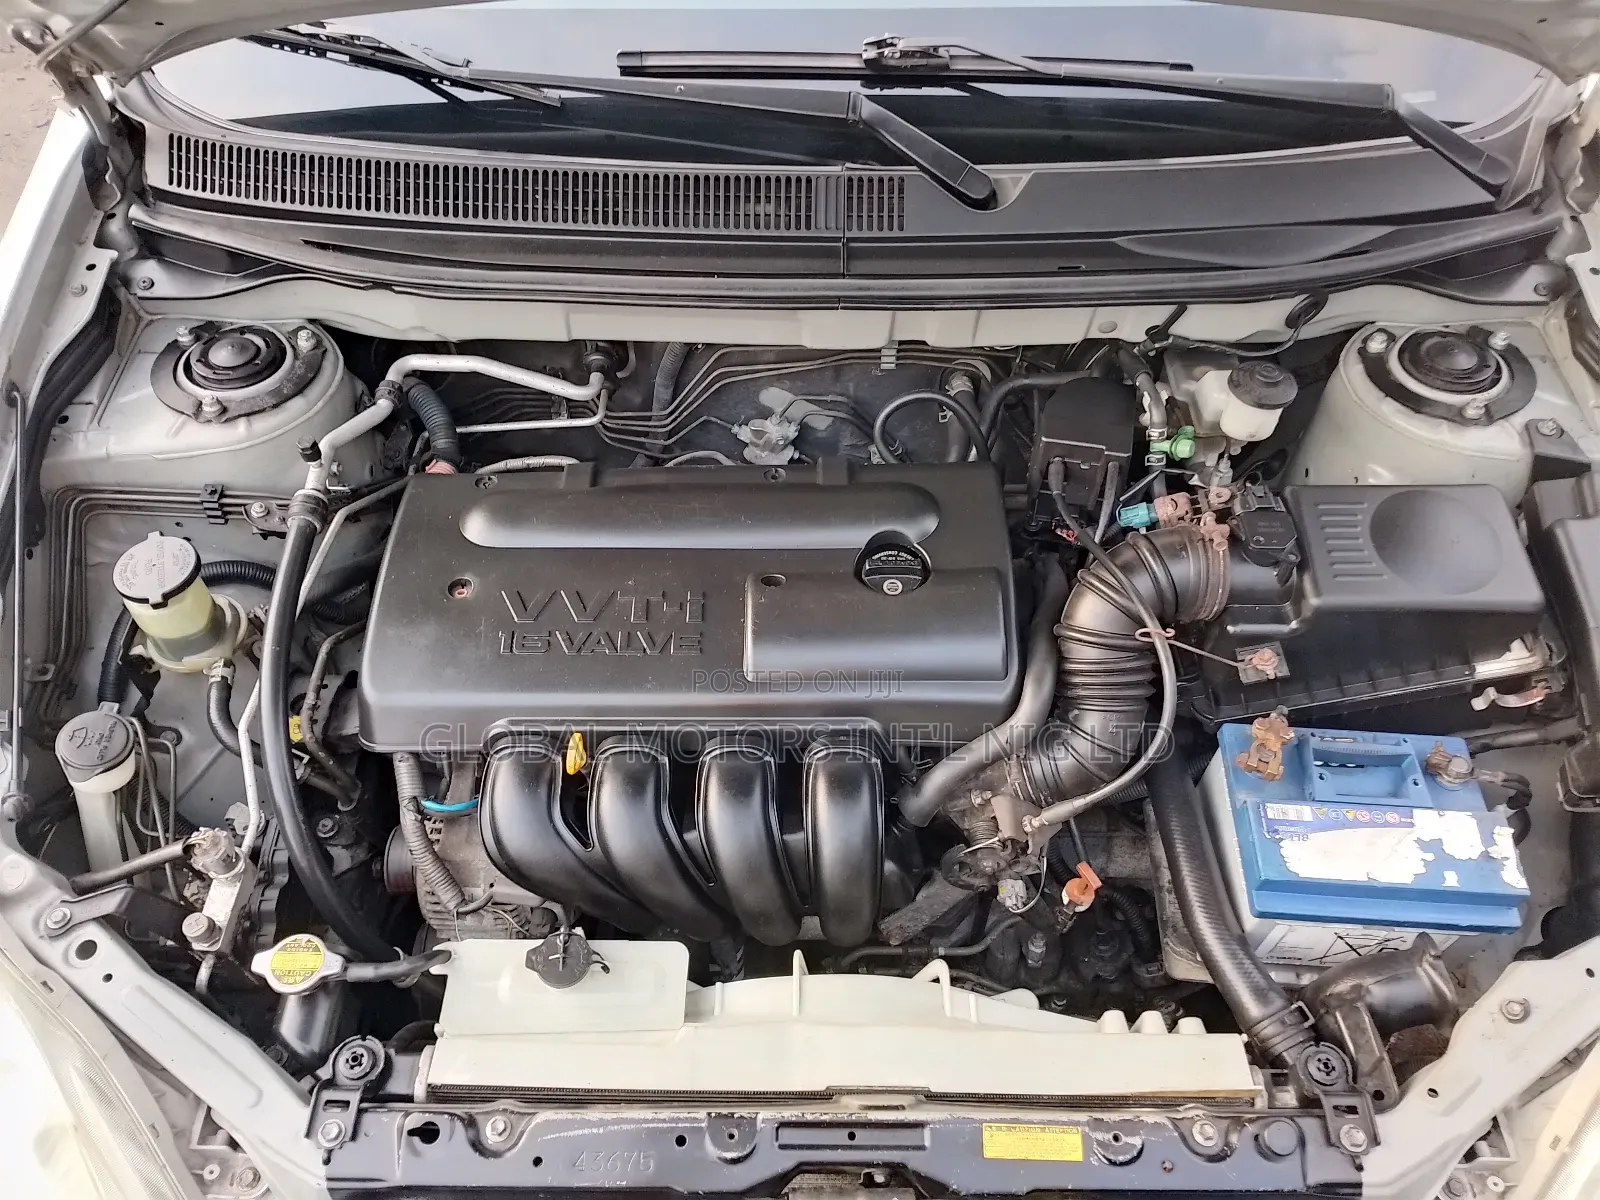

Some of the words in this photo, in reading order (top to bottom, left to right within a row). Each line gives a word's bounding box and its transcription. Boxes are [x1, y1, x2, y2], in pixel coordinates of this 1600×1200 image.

[498, 630, 551, 655] 16
[555, 630, 702, 656] VALVE
[274, 969, 312, 977] CAUTION
